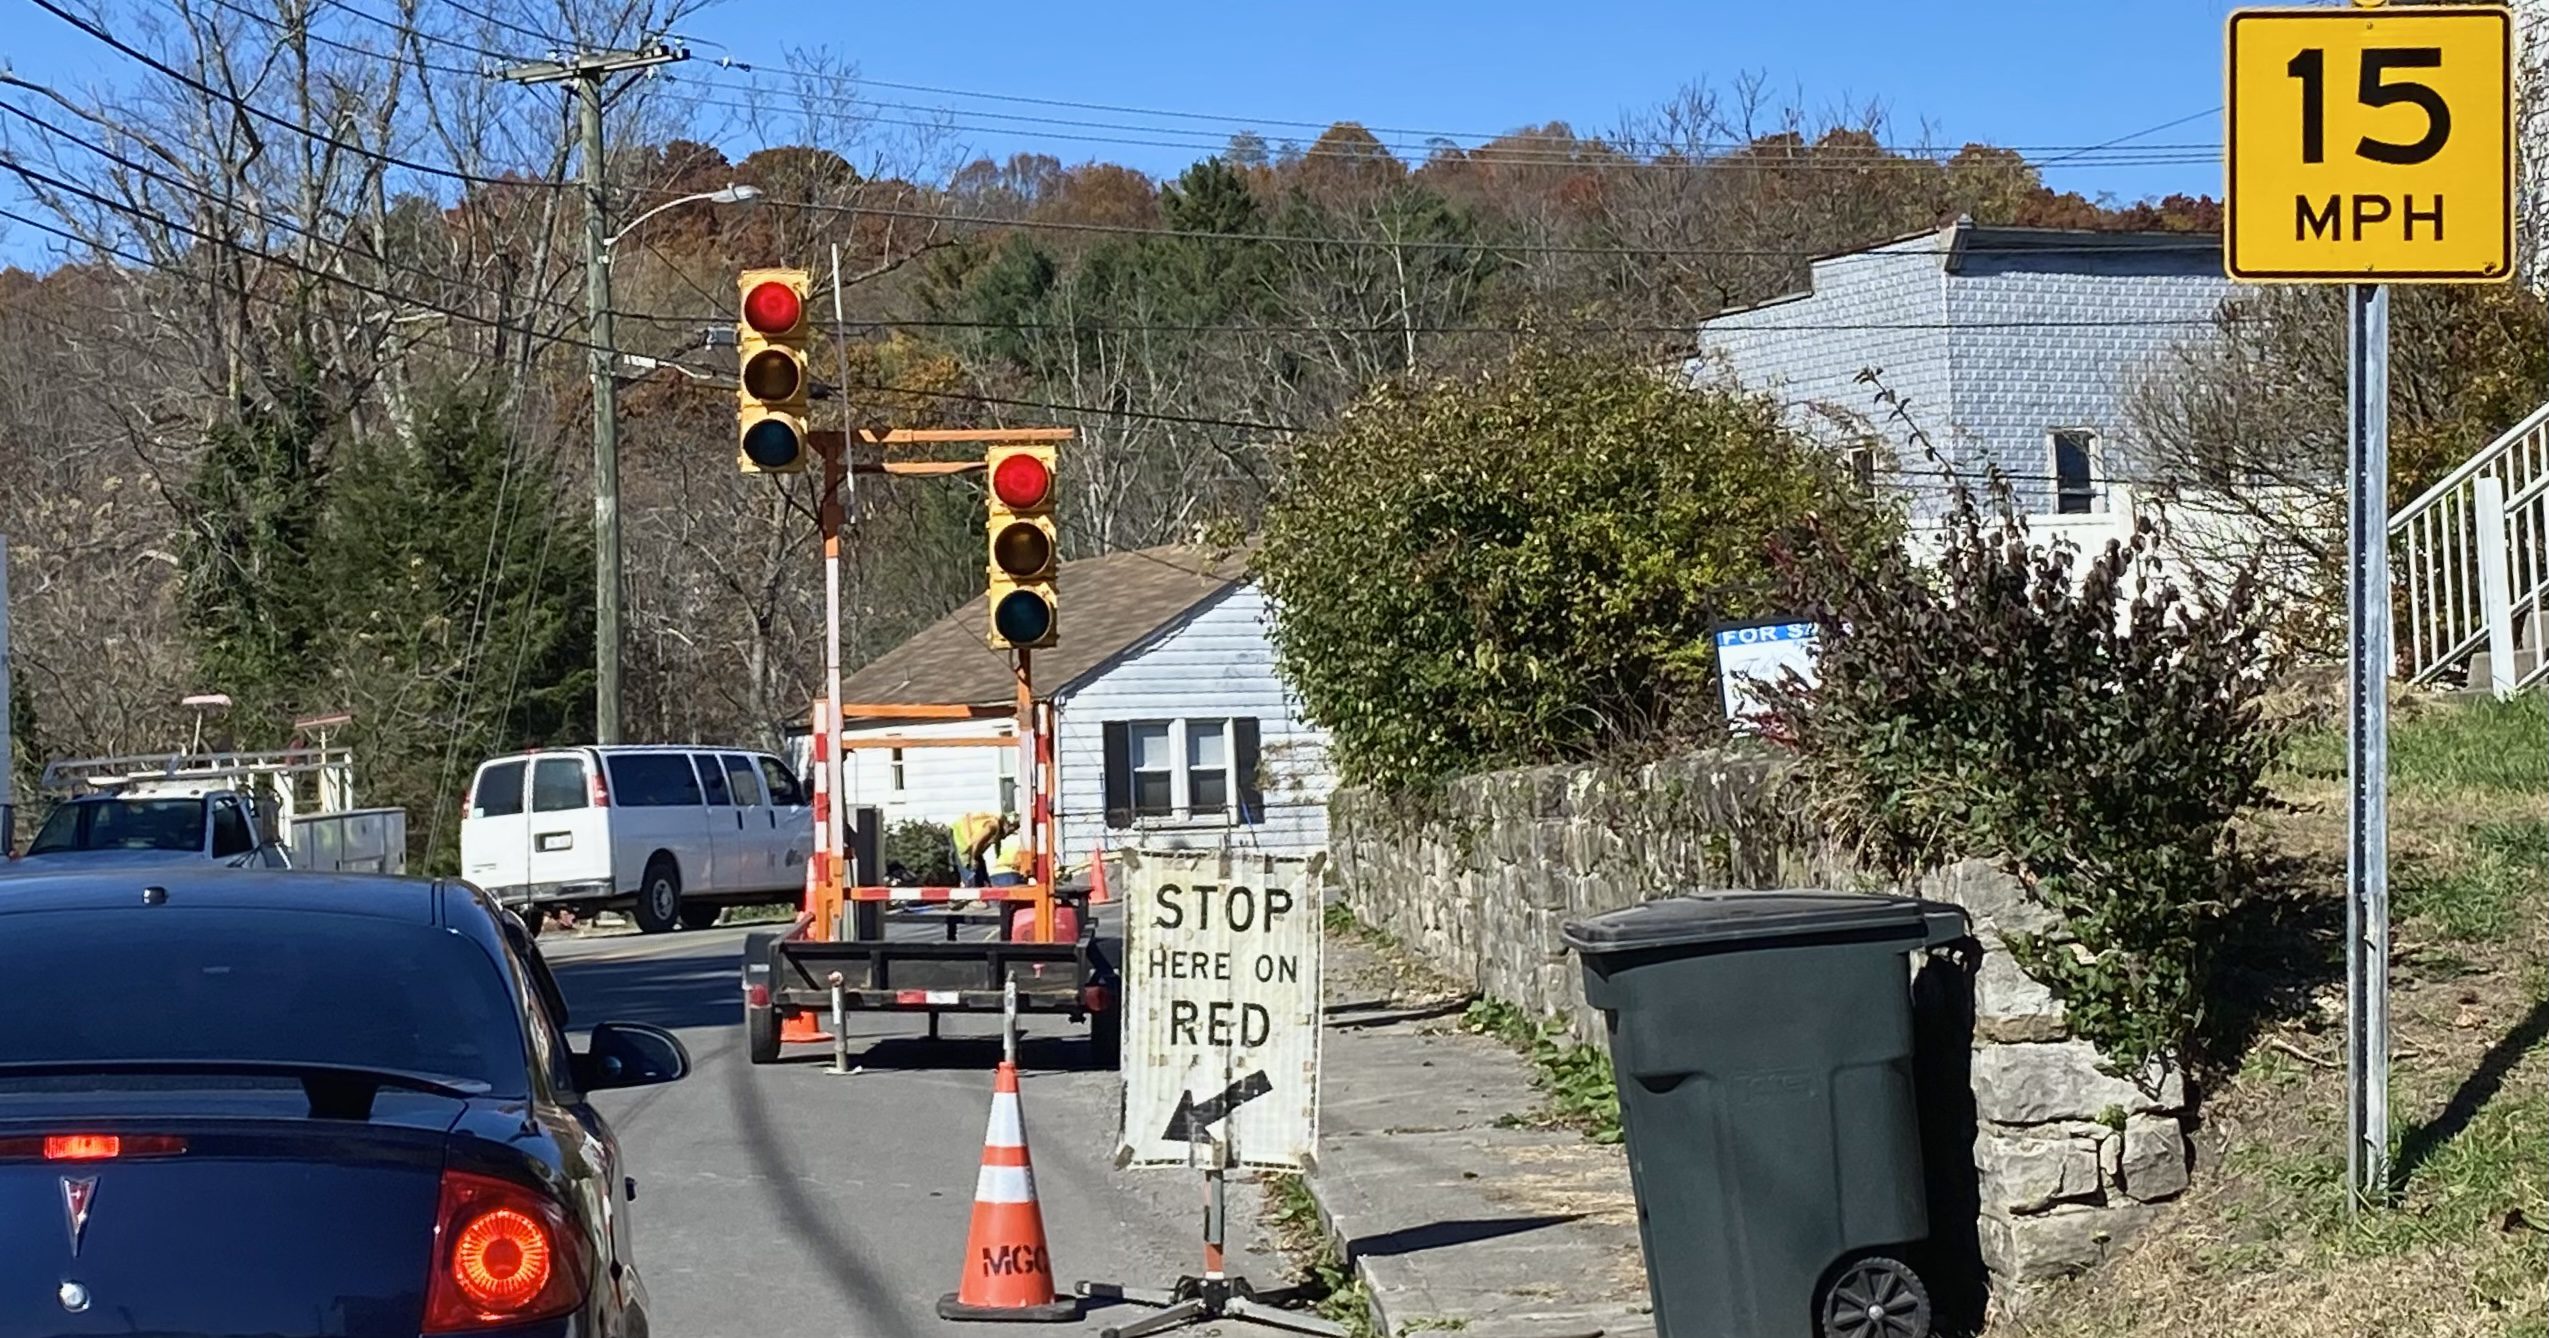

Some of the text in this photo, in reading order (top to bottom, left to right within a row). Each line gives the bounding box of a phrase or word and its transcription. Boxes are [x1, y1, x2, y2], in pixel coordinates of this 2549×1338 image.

[2287, 47, 2452, 166] 15
[2295, 194, 2444, 242] MPH
[1722, 626, 1778, 646] FOR
[1154, 883, 1294, 932] STOP
[1149, 950, 1298, 983] HERE ON
[1170, 1000, 1270, 1048] RED
